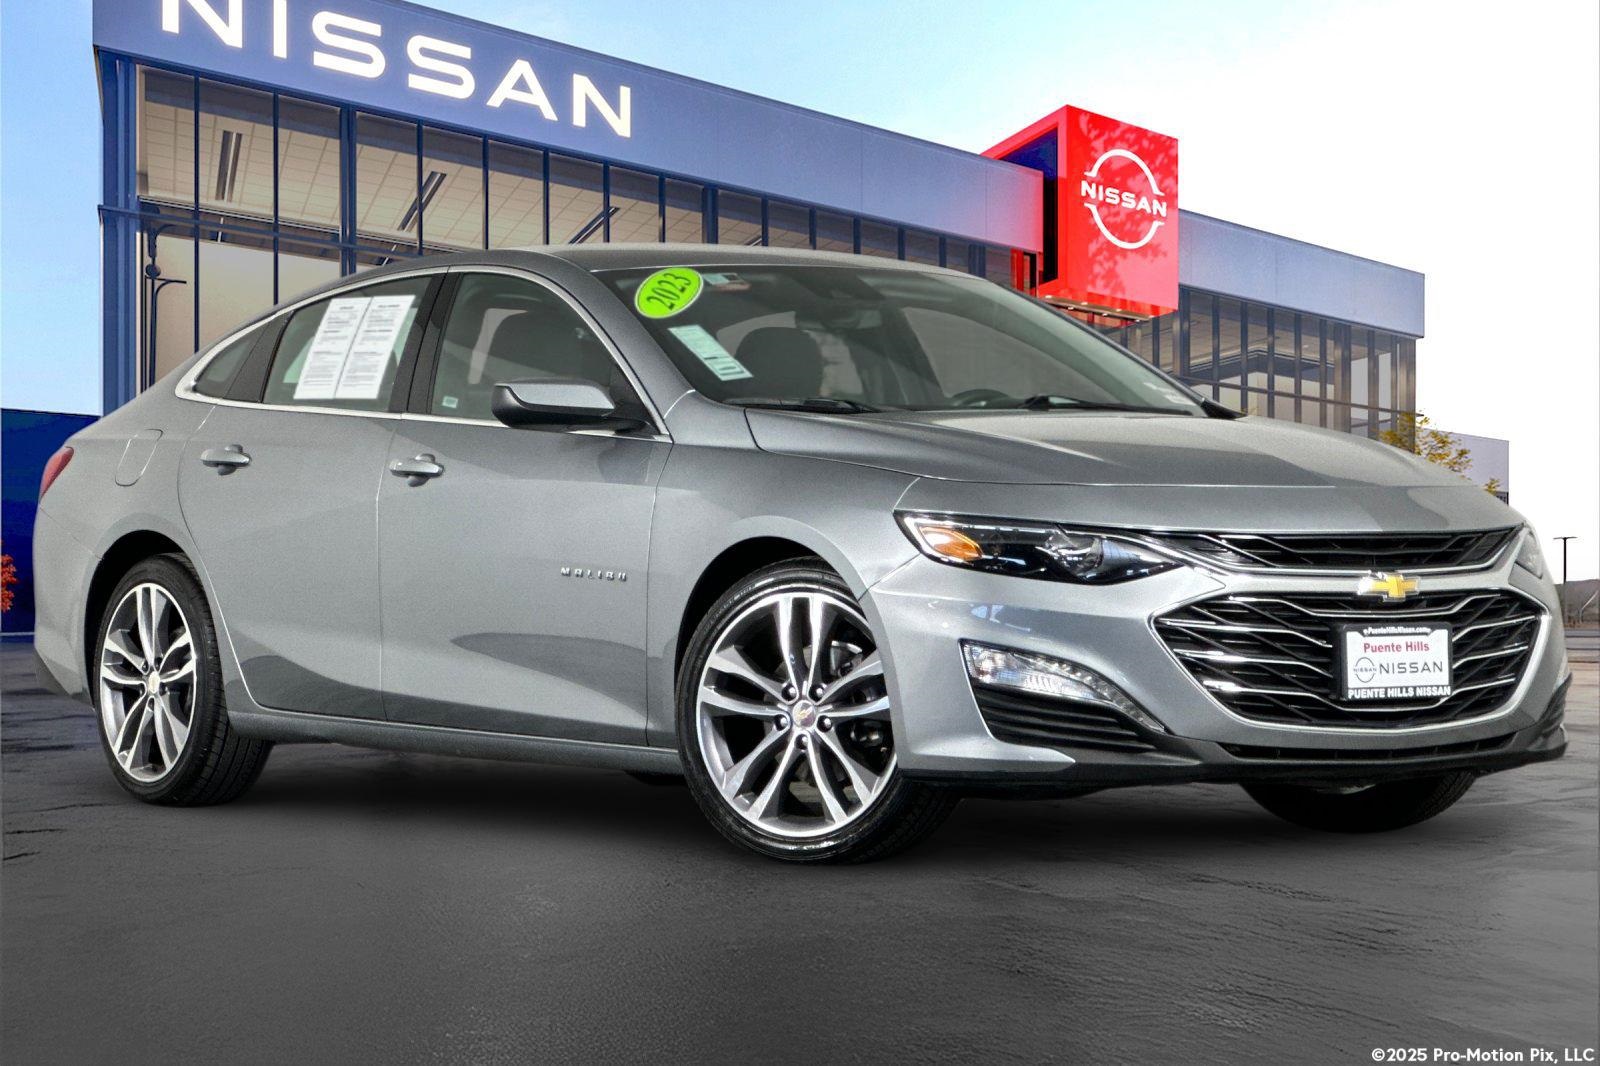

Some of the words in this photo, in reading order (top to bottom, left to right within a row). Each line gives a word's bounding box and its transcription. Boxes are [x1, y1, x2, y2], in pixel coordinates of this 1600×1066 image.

[161, 0, 632, 138] NISSAN
[1080, 180, 1167, 217] NISSAN
[646, 272, 692, 310] 2023
[560, 567, 627, 582] MALIBU
[1363, 642, 1402, 653] Puente
[1405, 641, 1430, 652] Hills
[1379, 661, 1443, 675] NISSAN
[1348, 689, 1386, 699] PUENTE
[1387, 687, 1415, 698] HILLS
[1416, 686, 1451, 697] NISSAN
